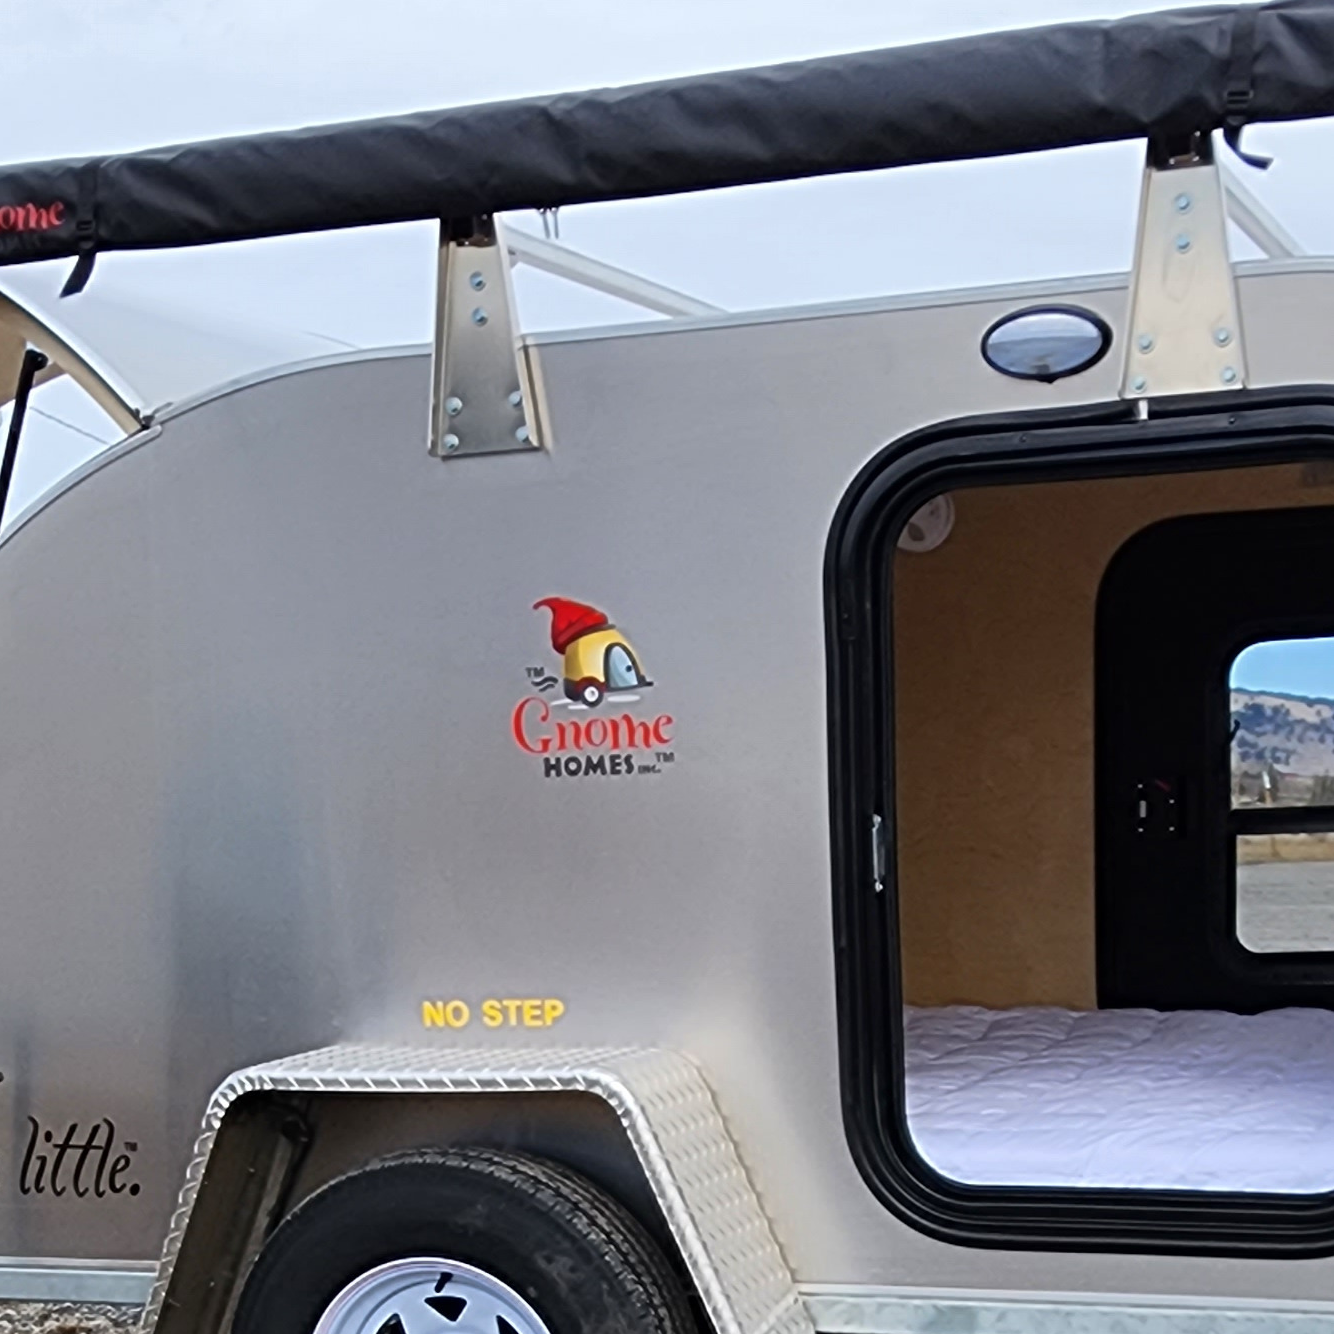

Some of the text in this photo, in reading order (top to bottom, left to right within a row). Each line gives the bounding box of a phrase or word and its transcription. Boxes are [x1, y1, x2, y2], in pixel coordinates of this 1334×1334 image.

[512, 697, 674, 754] Gnome
[543, 753, 634, 778] HOMES
[422, 999, 565, 1028] NO STEP
[19, 1115, 141, 1198] little.
